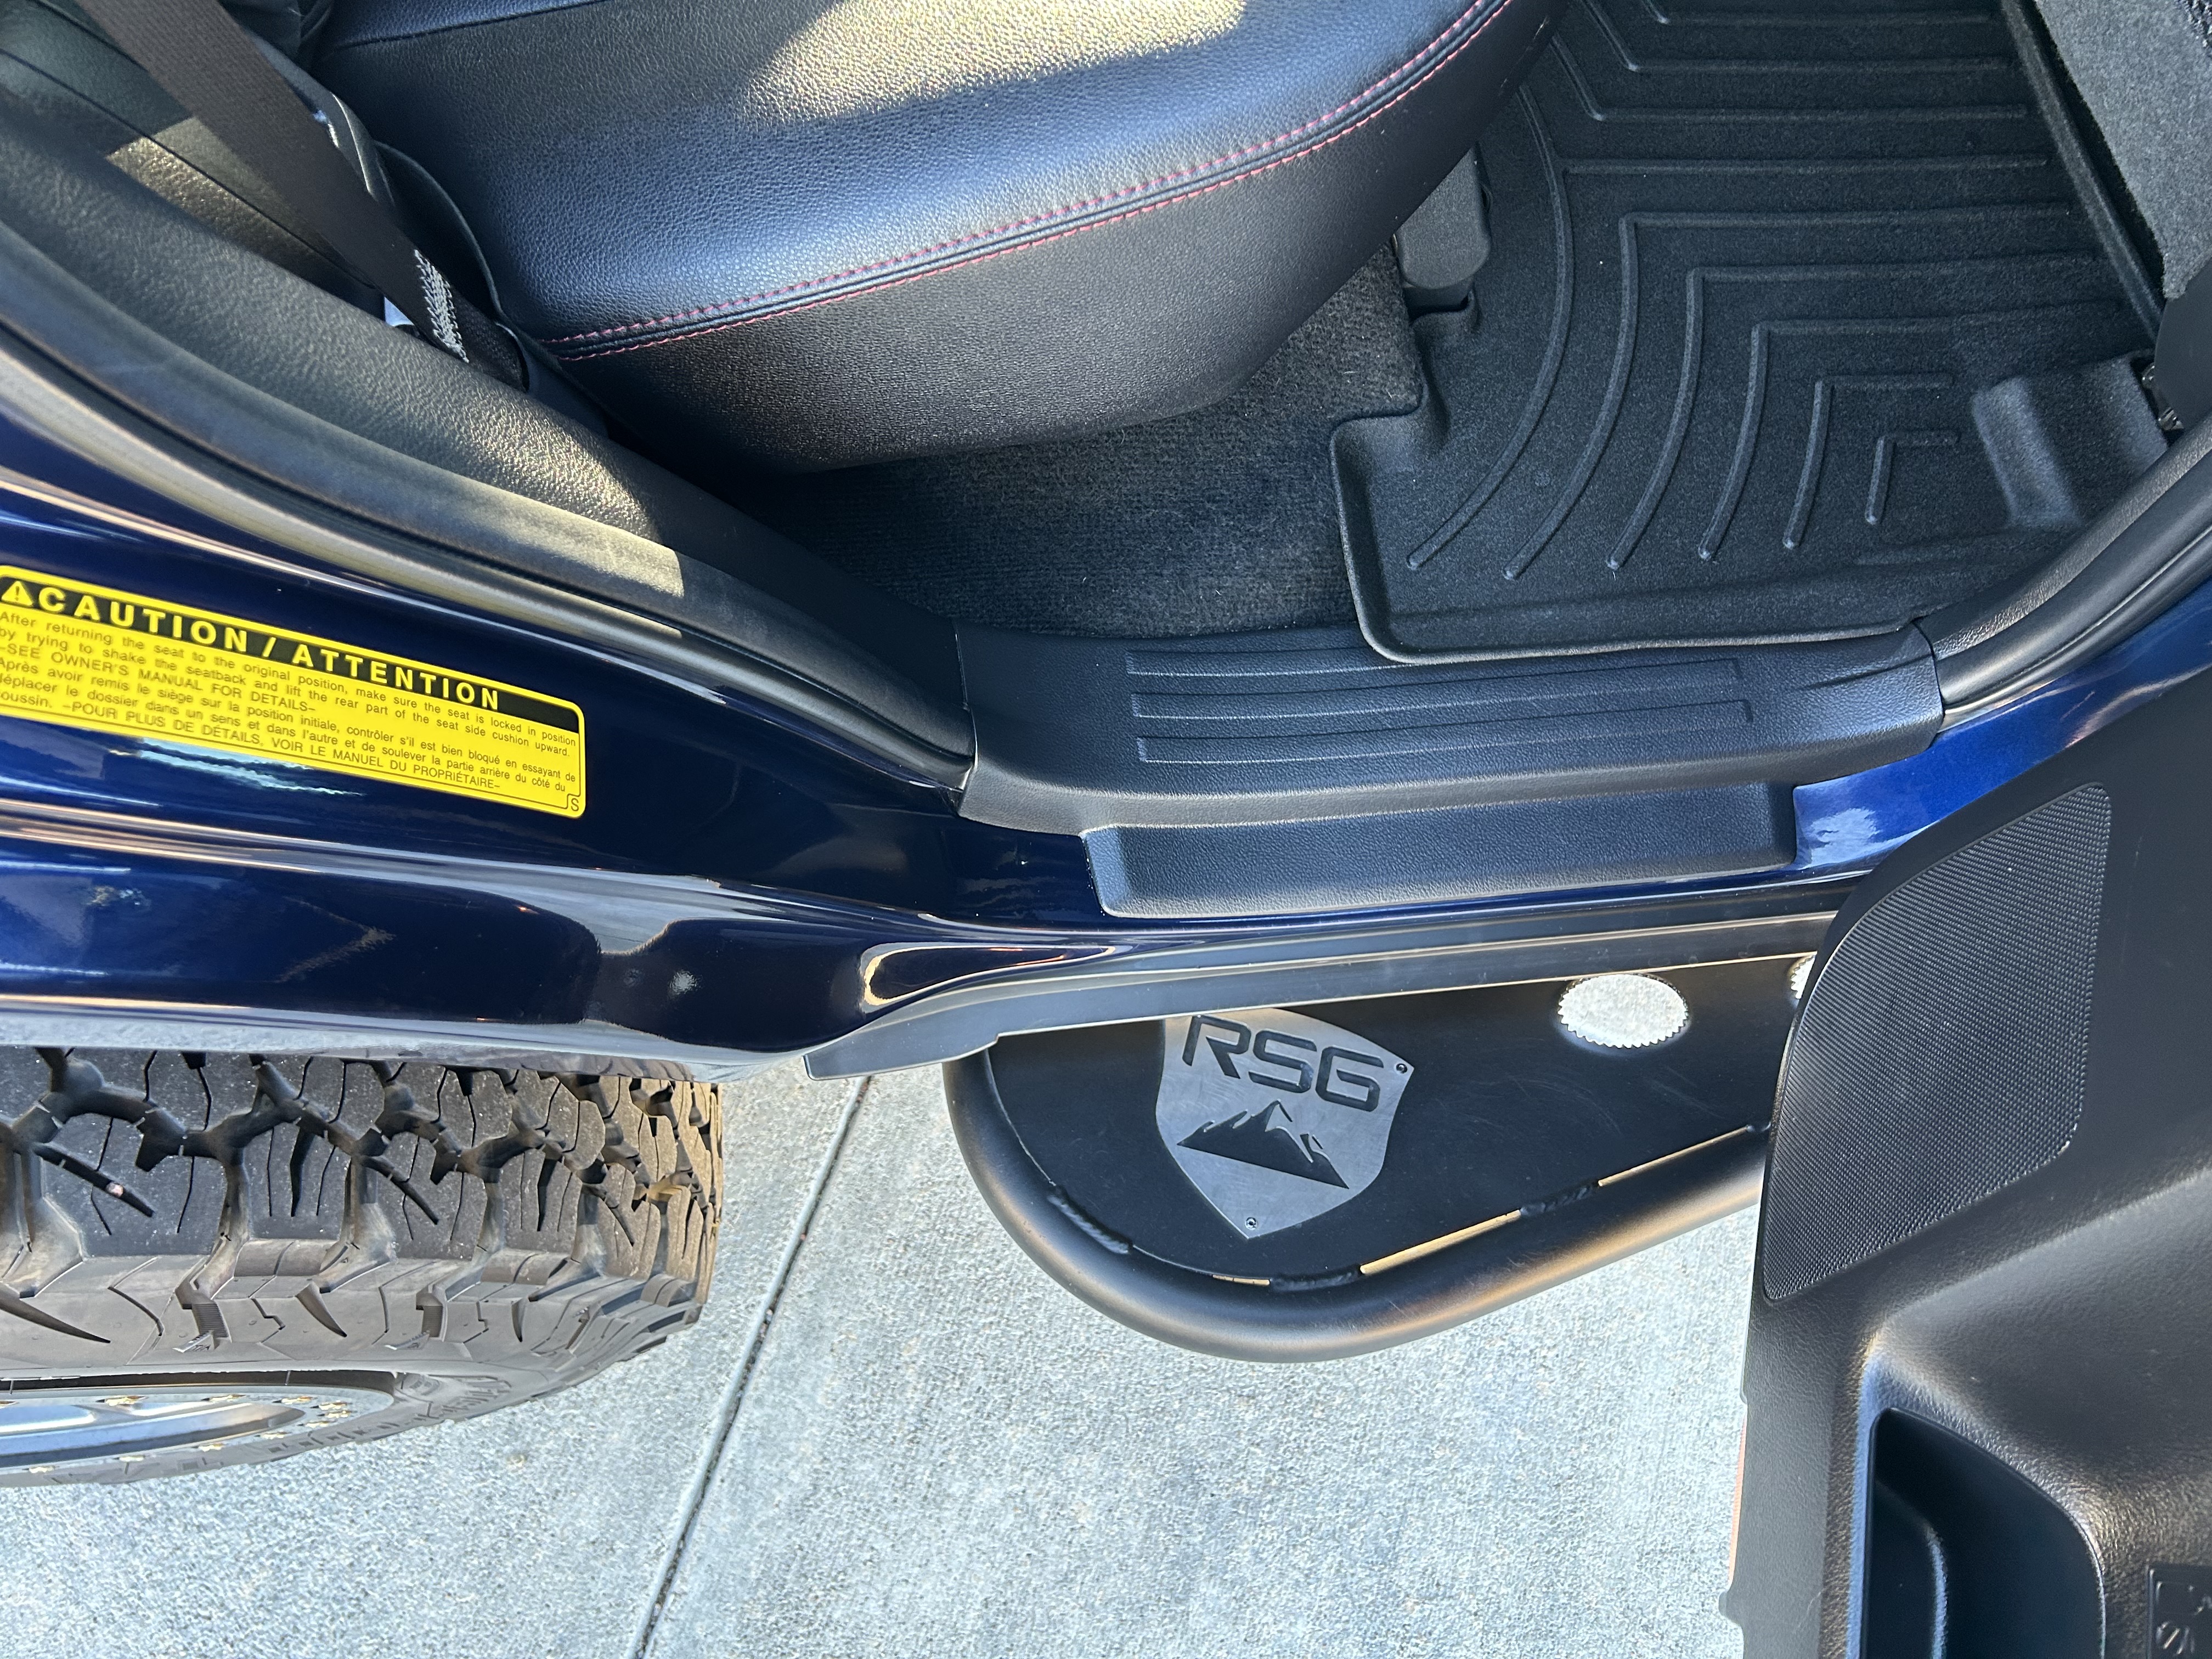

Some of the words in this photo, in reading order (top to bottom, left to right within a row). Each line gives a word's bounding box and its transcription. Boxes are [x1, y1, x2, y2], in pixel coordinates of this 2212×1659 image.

[0, 611, 36, 627] After
[47, 622, 112, 645] returning
[123, 637, 144, 650] the
[154, 645, 184, 658] seat
[193, 651, 206, 662] to
[214, 657, 235, 669] the
[244, 664, 290, 680] original
[298, 676, 347, 694] position,
[356, 689, 386, 701] make
[393, 697, 417, 708] sure
[425, 702, 441, 713] the
[448, 709, 469, 720] seat
[476, 714, 484, 723] is
[491, 717, 521, 732] locked
[528, 726, 536, 736] in
[543, 731, 575, 746] position
[26, 632, 68, 651] trying
[79, 642, 92, 654] to
[103, 648, 146, 664] shake
[155, 658, 177, 670] the
[186, 665, 246, 685] seatback
[255, 680, 277, 691] and
[287, 685, 301, 697] lift
[309, 690, 327, 702] the
[336, 696, 358, 708] rear
[366, 704, 388, 715] part
[395, 710, 405, 719] of
[413, 713, 429, 724] the
[437, 719, 458, 730] seat
[465, 725, 486, 736] side
[493, 731, 529, 746] cushion
[535, 742, 569, 757] upward.
[39, 587, 247, 652] CAUTION
[292, 644, 498, 710] ATTENTION
[51, 652, 129, 675] OWNER'S
[139, 669, 203, 691] MANUAL
[211, 684, 242, 698] FOR
[47, 668, 82, 681] avoir
[91, 676, 129, 691] remis
[137, 684, 150, 695] le
[157, 689, 193, 703] siège
[201, 697, 222, 707] sur
[229, 701, 239, 712] la
[248, 706, 293, 723] position
[301, 715, 340, 733] initiale,
[347, 726, 394, 742] contrôler
[400, 736, 414, 747] s'il
[421, 742, 436, 751] est
[442, 744, 462, 757] bien
[469, 750, 500, 764] bloqué
[506, 760, 517, 768] en
[522, 764, 560, 778] essayant
[566, 774, 575, 782] de
[66, 685, 78, 696] le
[87, 690, 138, 707] dossier
[146, 701, 179, 715] dans
[186, 709, 204, 720] un
[211, 714, 241, 726] sens
[248, 721, 259, 730] et
[267, 723, 296, 737] dans
[303, 729, 337, 745] l'autre
[345, 740, 355, 749] et
[362, 742, 375, 752] de
[382, 747, 426, 761] soulever
[432, 755, 441, 765] la
[447, 760, 474, 772] partie
[480, 766, 510, 779] arrière
[516, 774, 526, 783] du
[532, 777, 550, 788] côté
[555, 783, 565, 792] du
[126, 712, 165, 727] PLUS
[173, 720, 194, 732] DE
[272, 737, 303, 753] VOIR
[311, 744, 326, 756] LE
[333, 749, 383, 767] MANUEL
[390, 760, 407, 772] DU
[571, 798, 579, 811] S
[1182, 1014, 1384, 1112] RSG
